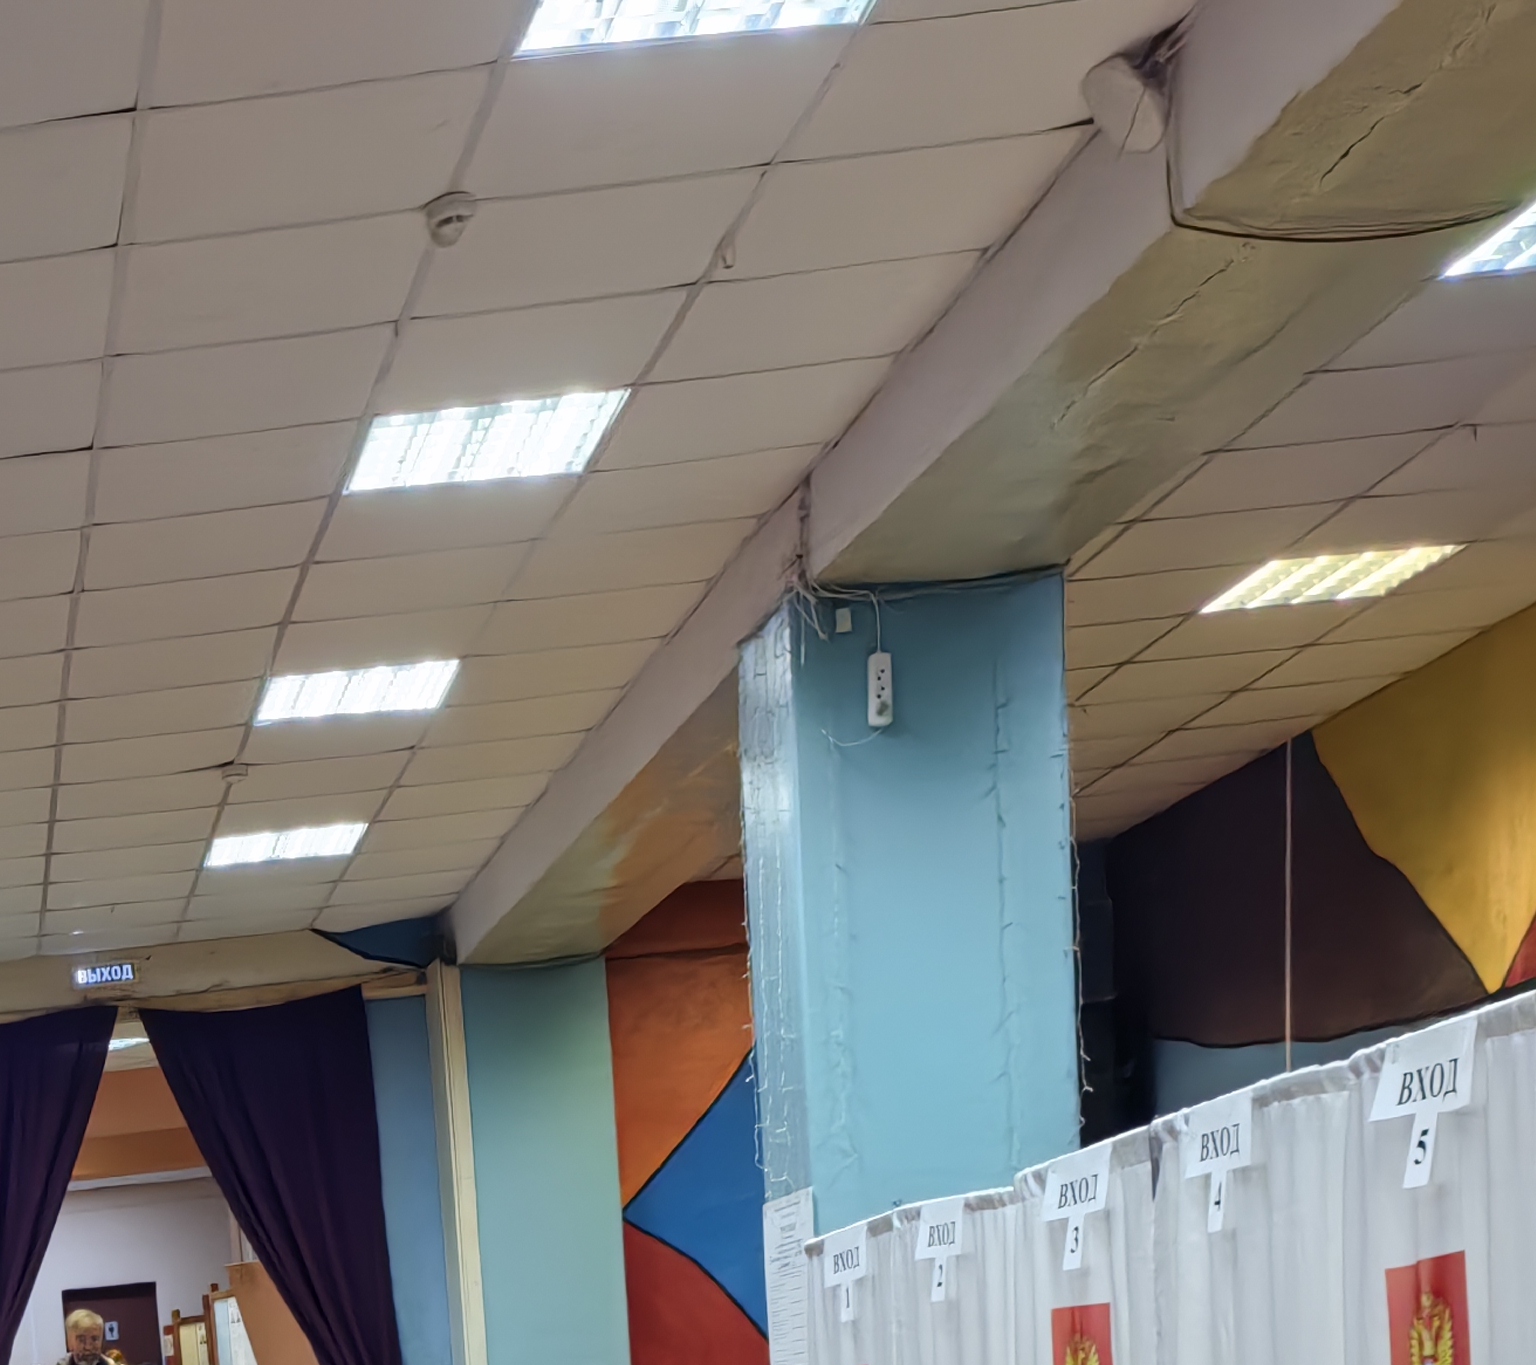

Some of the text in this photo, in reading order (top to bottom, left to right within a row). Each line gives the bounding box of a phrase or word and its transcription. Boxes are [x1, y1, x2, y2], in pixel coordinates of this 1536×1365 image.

[77, 964, 134, 984] ВЫХОД
[1396, 1057, 1459, 1106] ВХОД
[1199, 1123, 1241, 1162] ВХОД
[1414, 1129, 1429, 1165] 5
[1057, 1173, 1099, 1209] ВХОД
[1213, 1181, 1222, 1211] 4
[927, 1221, 956, 1248] ВХОД
[1070, 1226, 1079, 1253] 3
[832, 1246, 860, 1274] ВХОД
[936, 1264, 943, 1287] 2
[845, 1286, 850, 1309] 1
